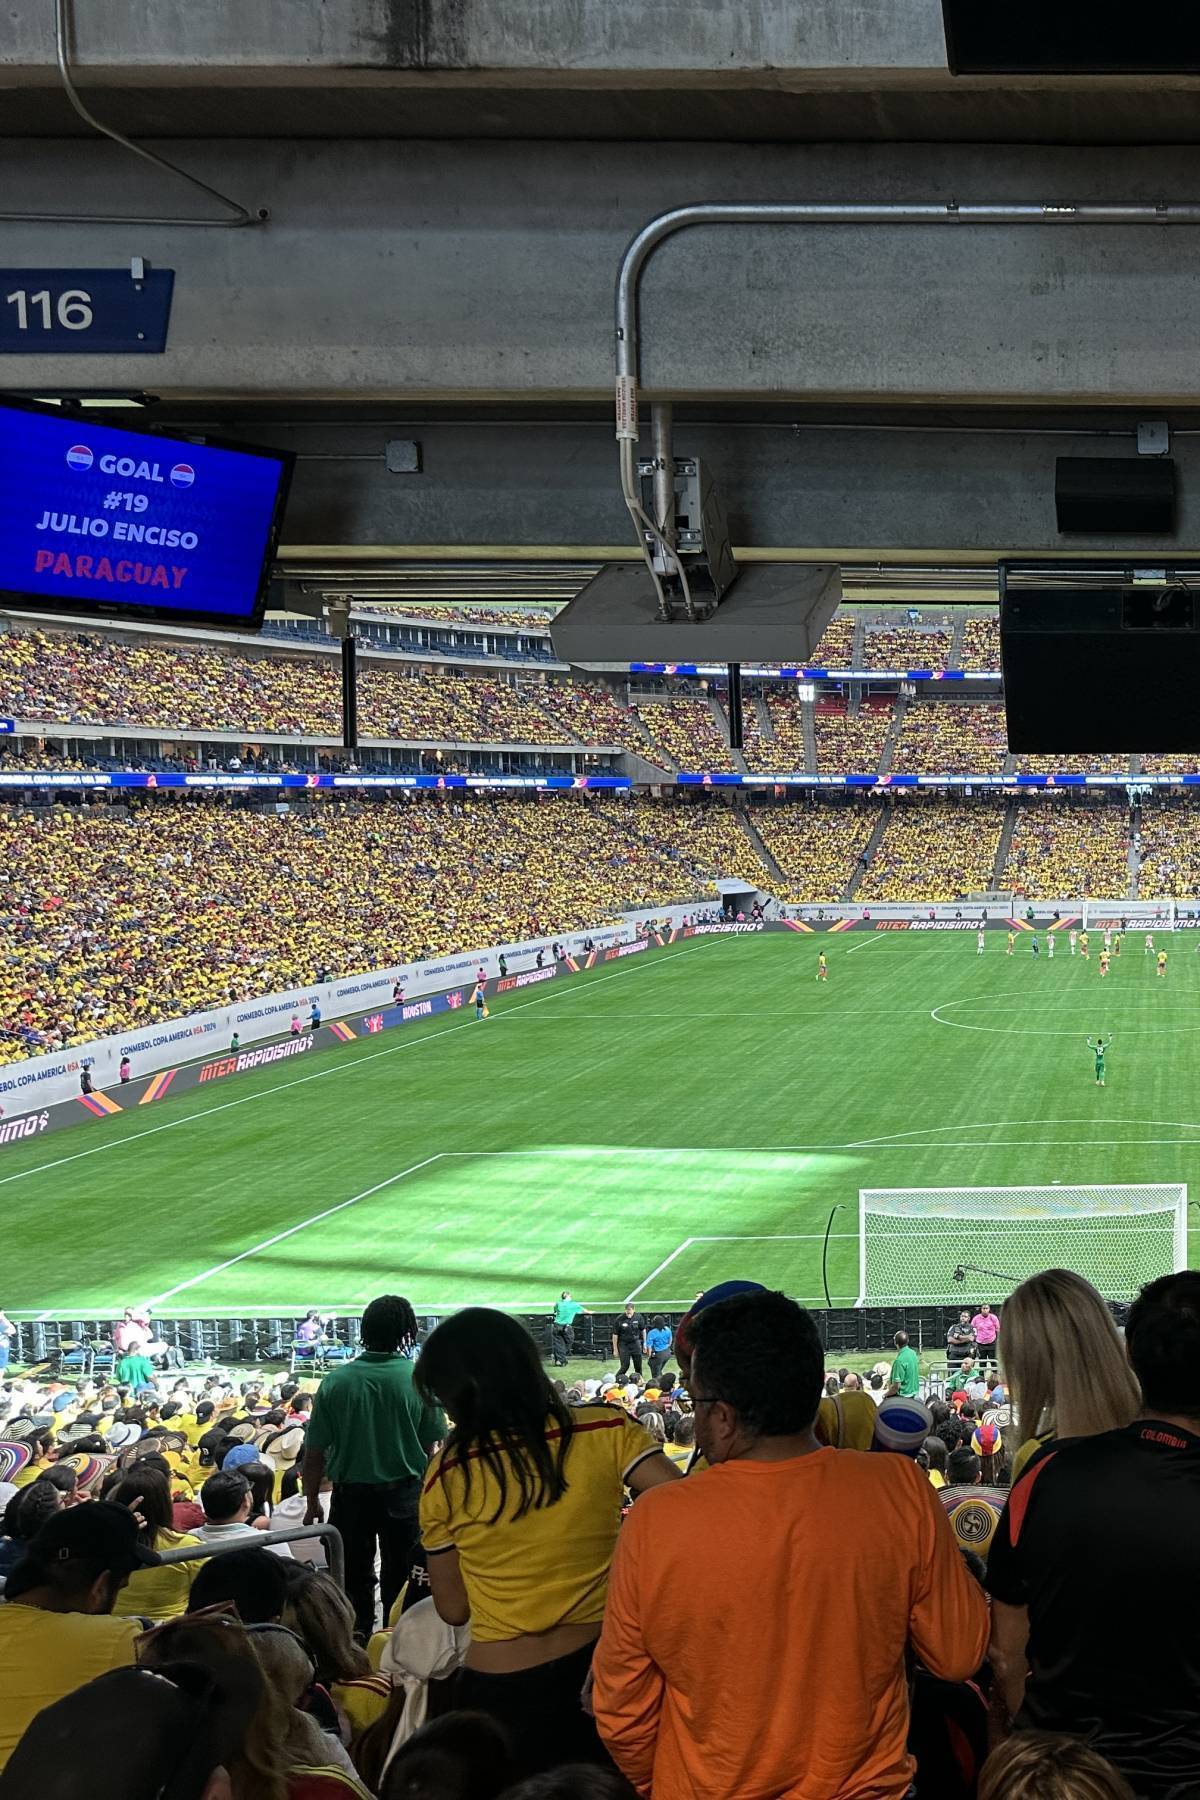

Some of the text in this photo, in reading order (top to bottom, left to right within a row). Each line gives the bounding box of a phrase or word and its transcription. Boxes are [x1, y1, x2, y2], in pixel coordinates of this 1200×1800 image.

[7, 289, 93, 330] 116
[99, 454, 164, 482] GOAL
[103, 490, 149, 513] #19
[36, 511, 199, 550] JULIO ENCISO
[34, 549, 188, 589] PARAGUAY
[236, 1009, 265, 1023] CONMEBOL
[264, 1006, 278, 1016] COPA
[278, 1000, 299, 1012] AMERICA
[402, 1000, 432, 1020] HOUSTON
[120, 1039, 152, 1057] CONMEBOL
[152, 1035, 168, 1047] COPA
[167, 1028, 193, 1044] AMERICA
[203, 1023, 217, 1035] 2024
[17, 1073, 37, 1088] COPA
[37, 1065, 67, 1081] AMERICA
[66, 1061, 80, 1073] USA
[1140, 1428, 1188, 1449] COLOMBIA
